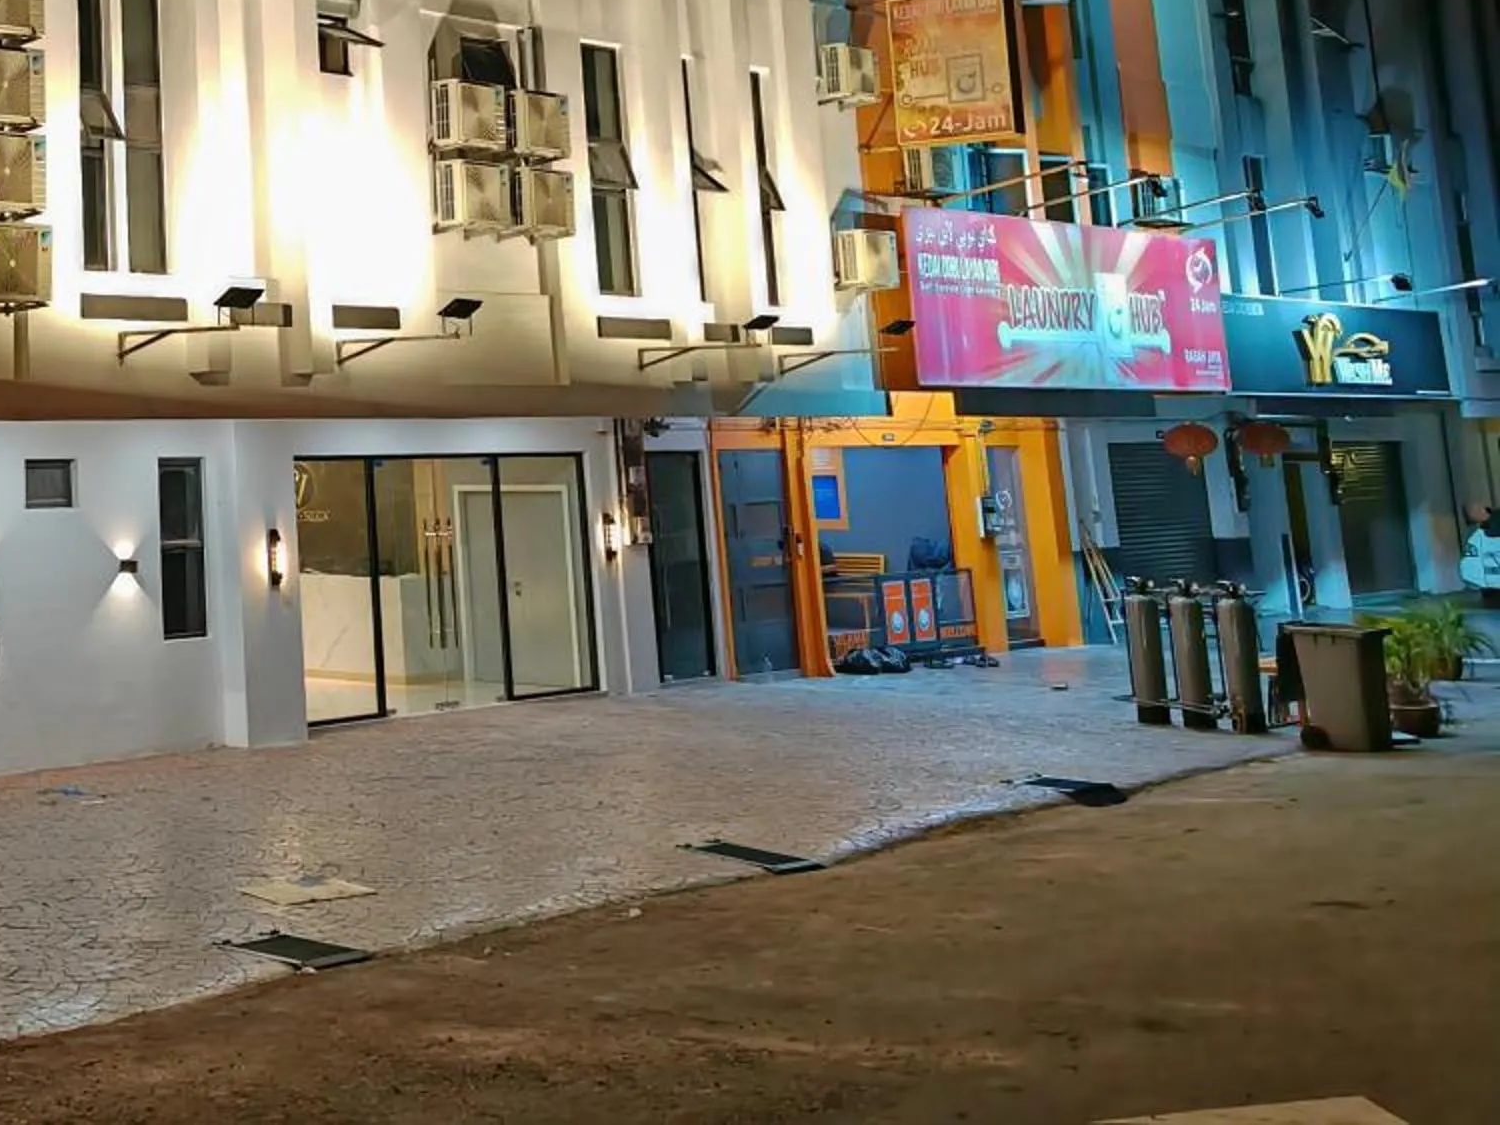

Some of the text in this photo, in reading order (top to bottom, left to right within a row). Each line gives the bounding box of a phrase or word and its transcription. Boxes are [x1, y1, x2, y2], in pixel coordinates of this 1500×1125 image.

[930, 110, 1007, 136] 24-Jam
[1008, 284, 1165, 335] LAUNDRY HUB
